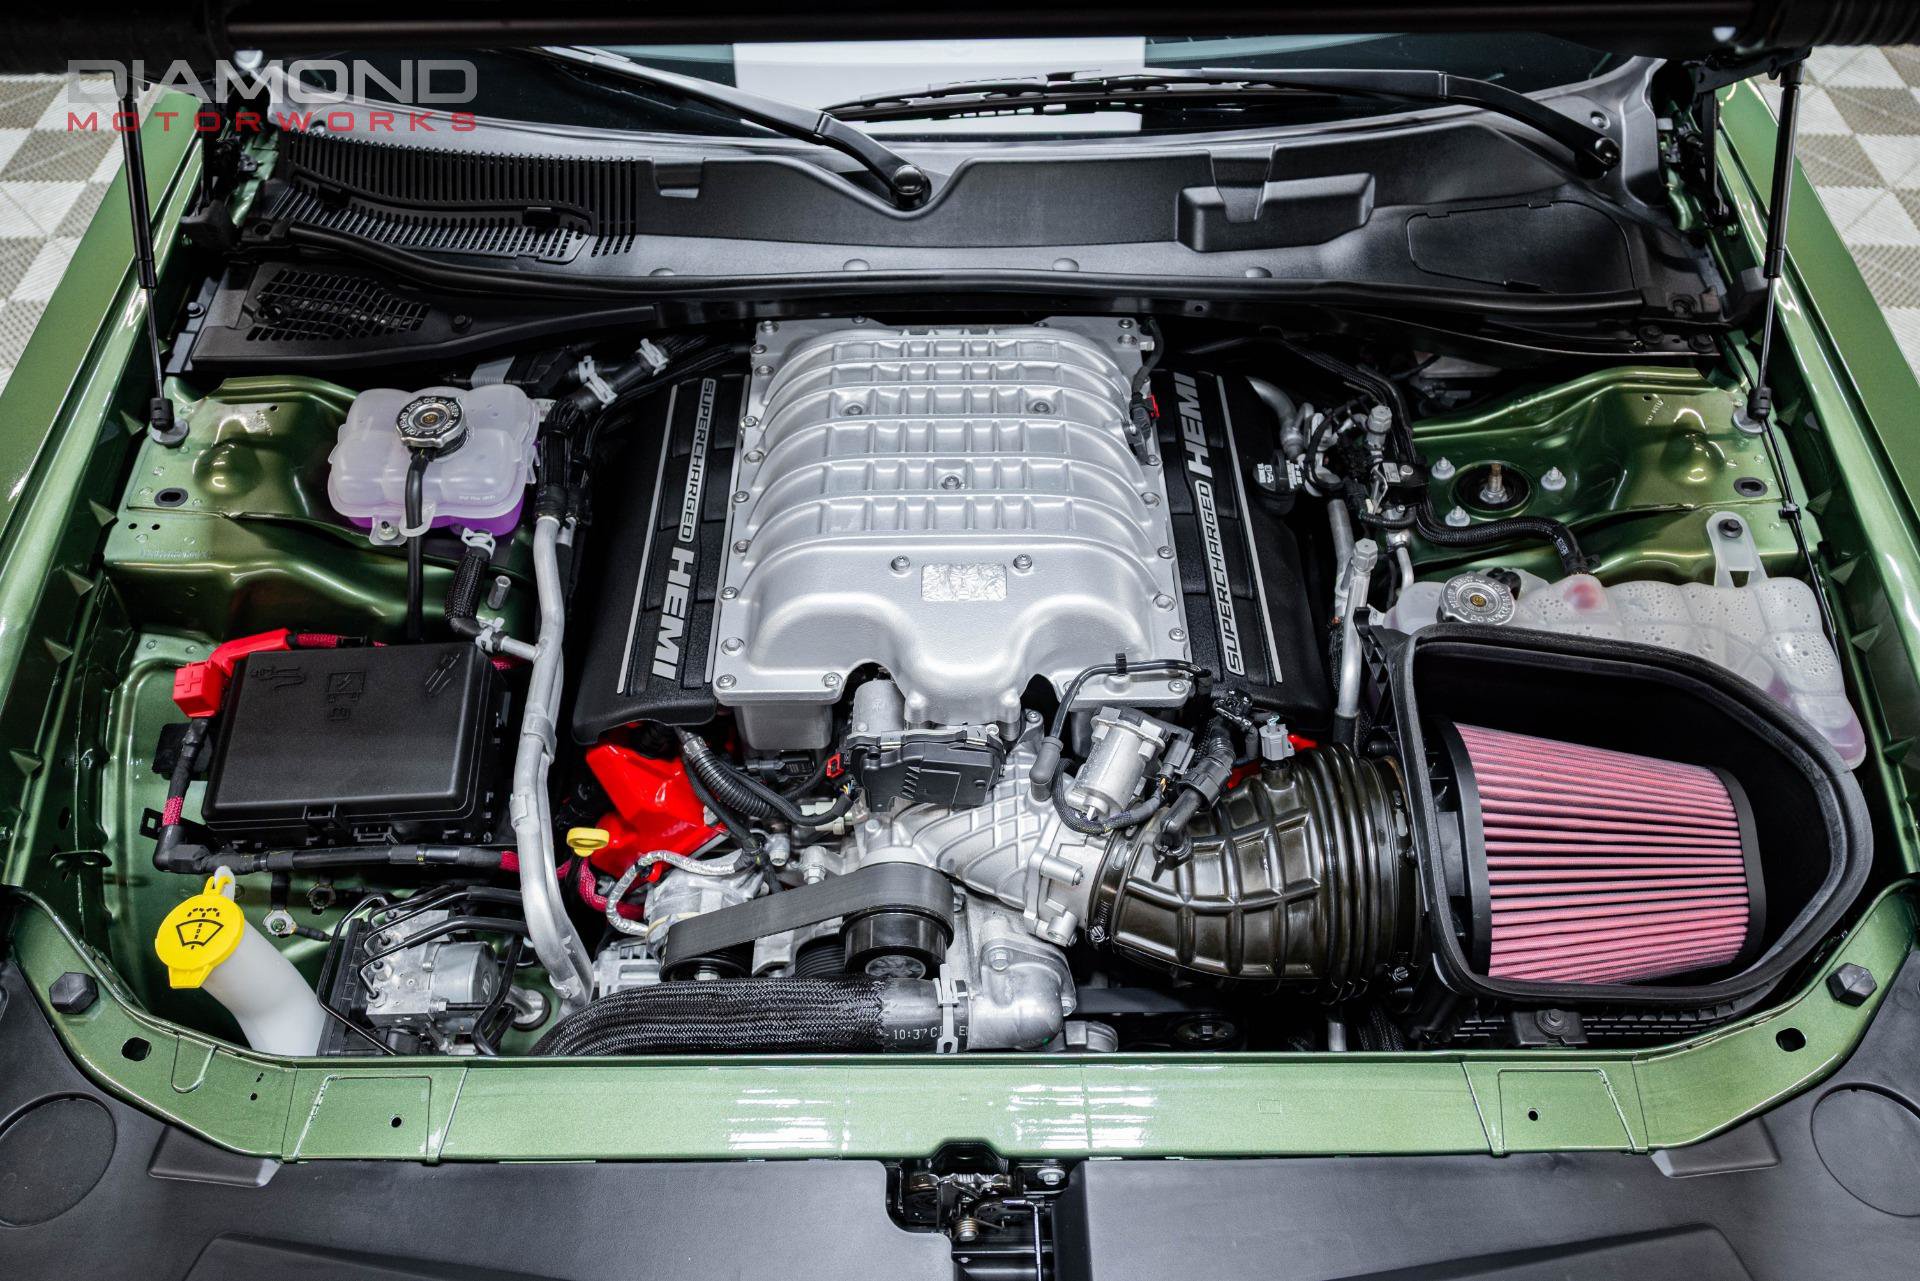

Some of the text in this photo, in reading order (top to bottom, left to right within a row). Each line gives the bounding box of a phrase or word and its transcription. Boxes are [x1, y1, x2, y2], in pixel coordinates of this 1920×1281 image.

[652, 379, 716, 681] SUPERCHARGED HEMI
[1173, 372, 1244, 674] SUPERCHARGED HEMI
[893, 1028, 928, 1040] 10:37
